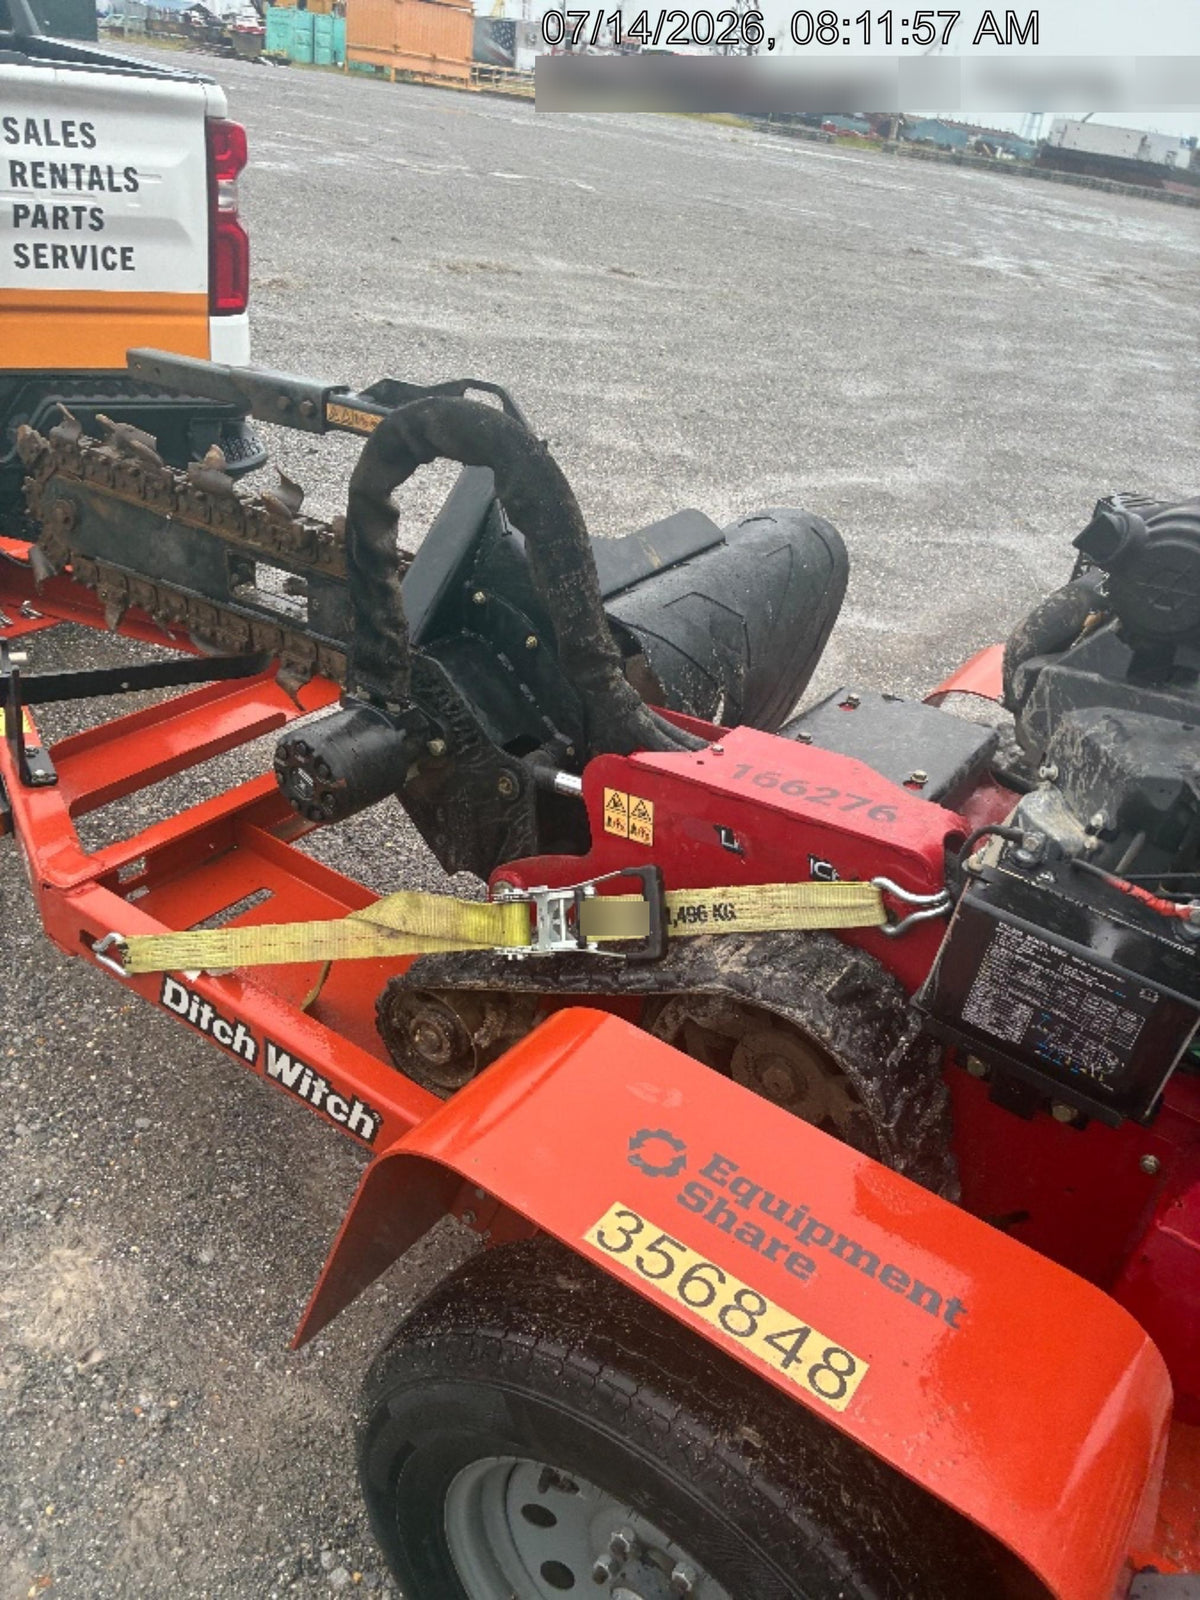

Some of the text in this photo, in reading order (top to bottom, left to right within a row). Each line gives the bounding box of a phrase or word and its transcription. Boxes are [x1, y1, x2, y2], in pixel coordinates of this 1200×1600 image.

[2, 116, 97, 149] SALES
[8, 159, 140, 193] RENTALS
[12, 203, 105, 232] PARTS
[13, 242, 136, 271] SERVICE
[731, 763, 899, 823] 166276
[712, 902, 737, 922] KG
[162, 977, 376, 1140] Ditch Witch
[676, 1181, 817, 1282] Share
[698, 1152, 969, 1330] Equipment
[596, 1209, 857, 1401] 356848
